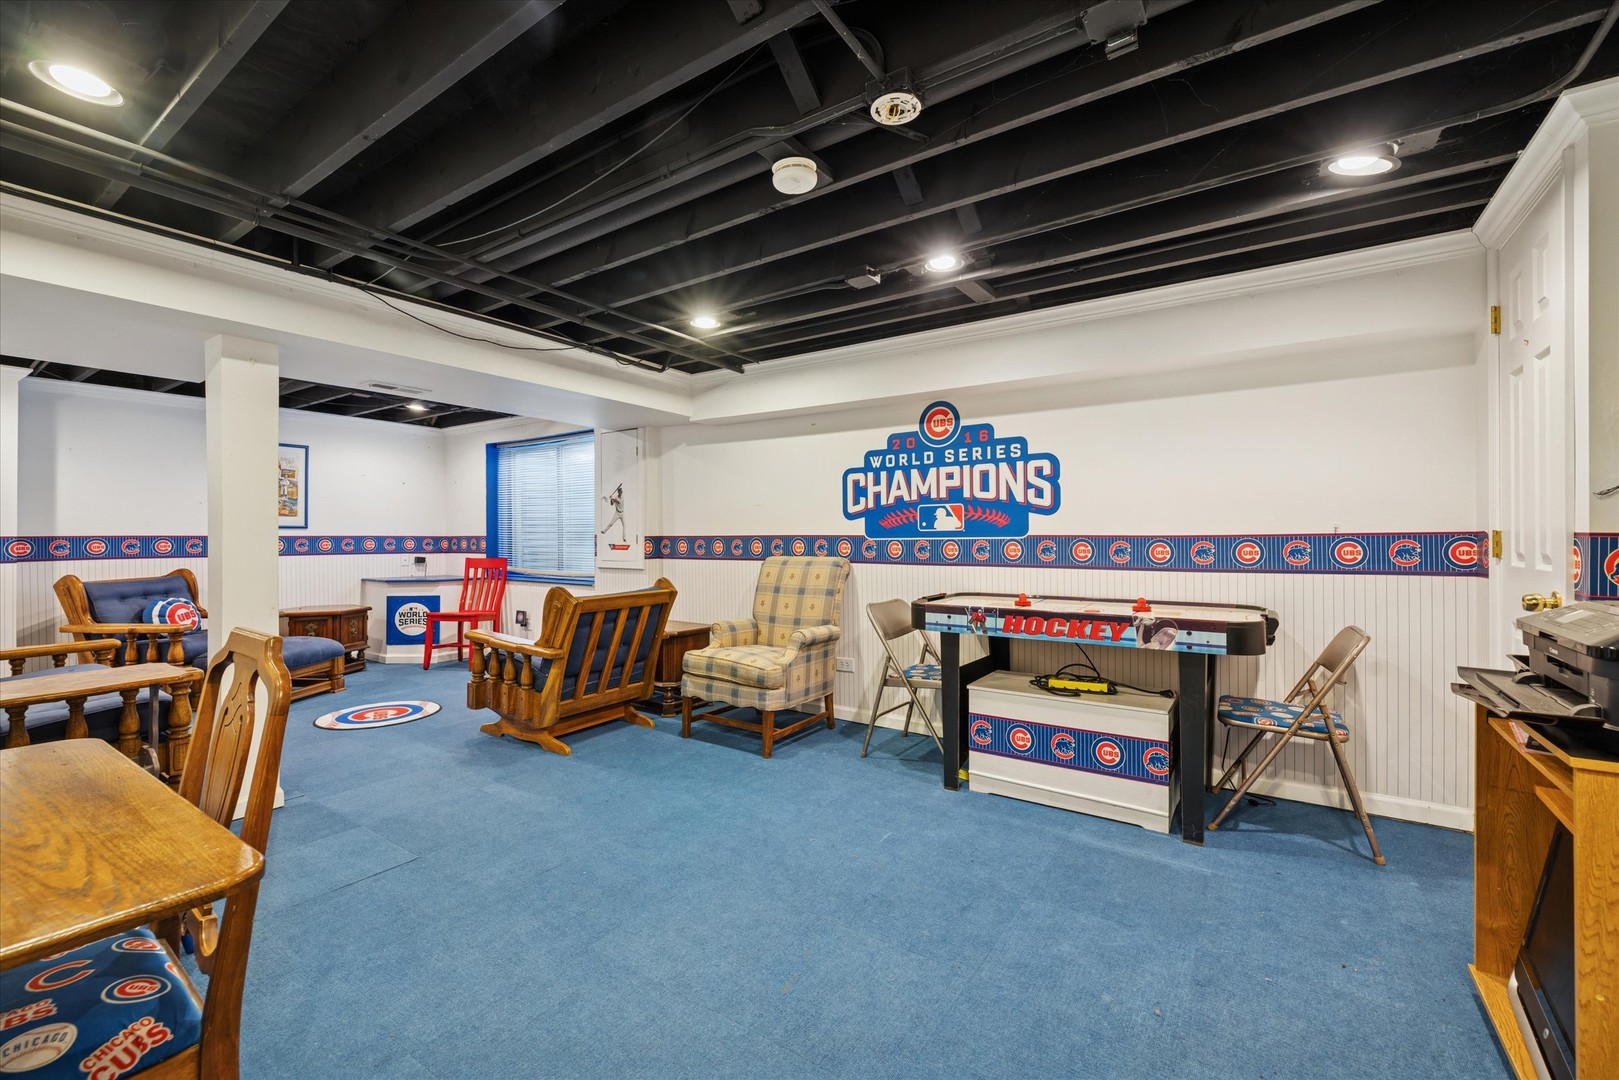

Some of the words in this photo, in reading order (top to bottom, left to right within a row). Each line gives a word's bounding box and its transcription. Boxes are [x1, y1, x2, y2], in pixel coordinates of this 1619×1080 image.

[869, 451, 934, 468] WORLD
[944, 443, 1022, 463] SERIES
[846, 458, 1054, 515] CHAMPIONS
[398, 618, 427, 627] SERIES
[1002, 614, 1131, 642] HOCKEY
[2, 1031, 69, 1058] CHICAGO
